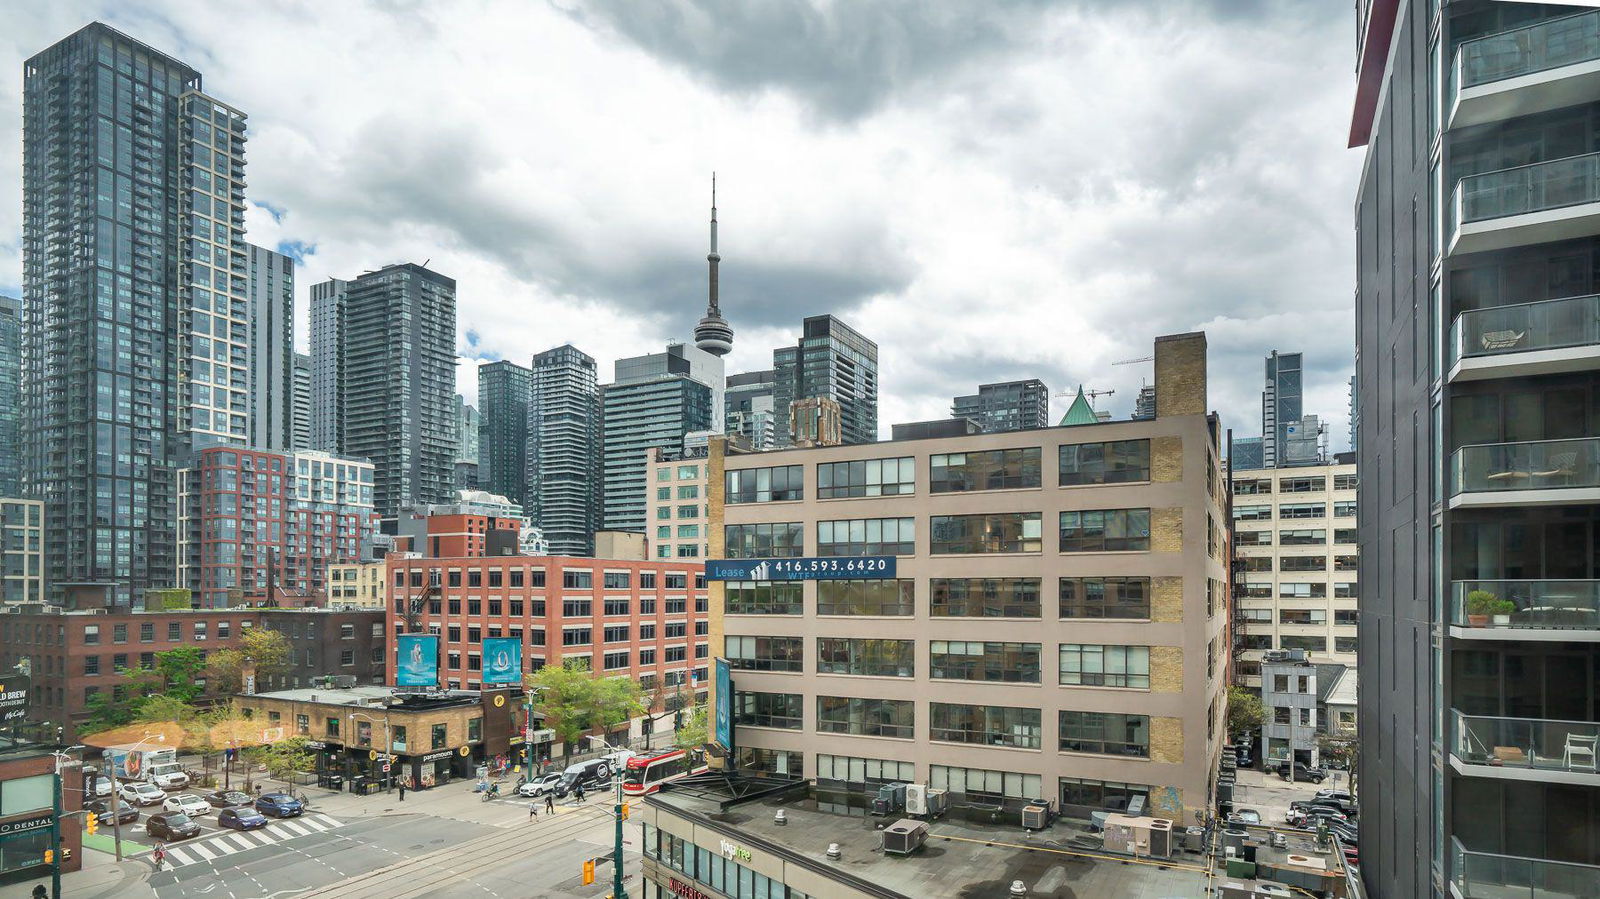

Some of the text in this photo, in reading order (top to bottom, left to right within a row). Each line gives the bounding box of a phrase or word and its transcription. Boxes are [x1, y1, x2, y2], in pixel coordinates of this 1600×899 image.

[715, 566, 745, 577] Lease
[775, 560, 886, 572] 416.593.6420
[8, 690, 26, 699] BREW
[423, 751, 453, 762] paramount
[14, 818, 53, 830] DENTAL
